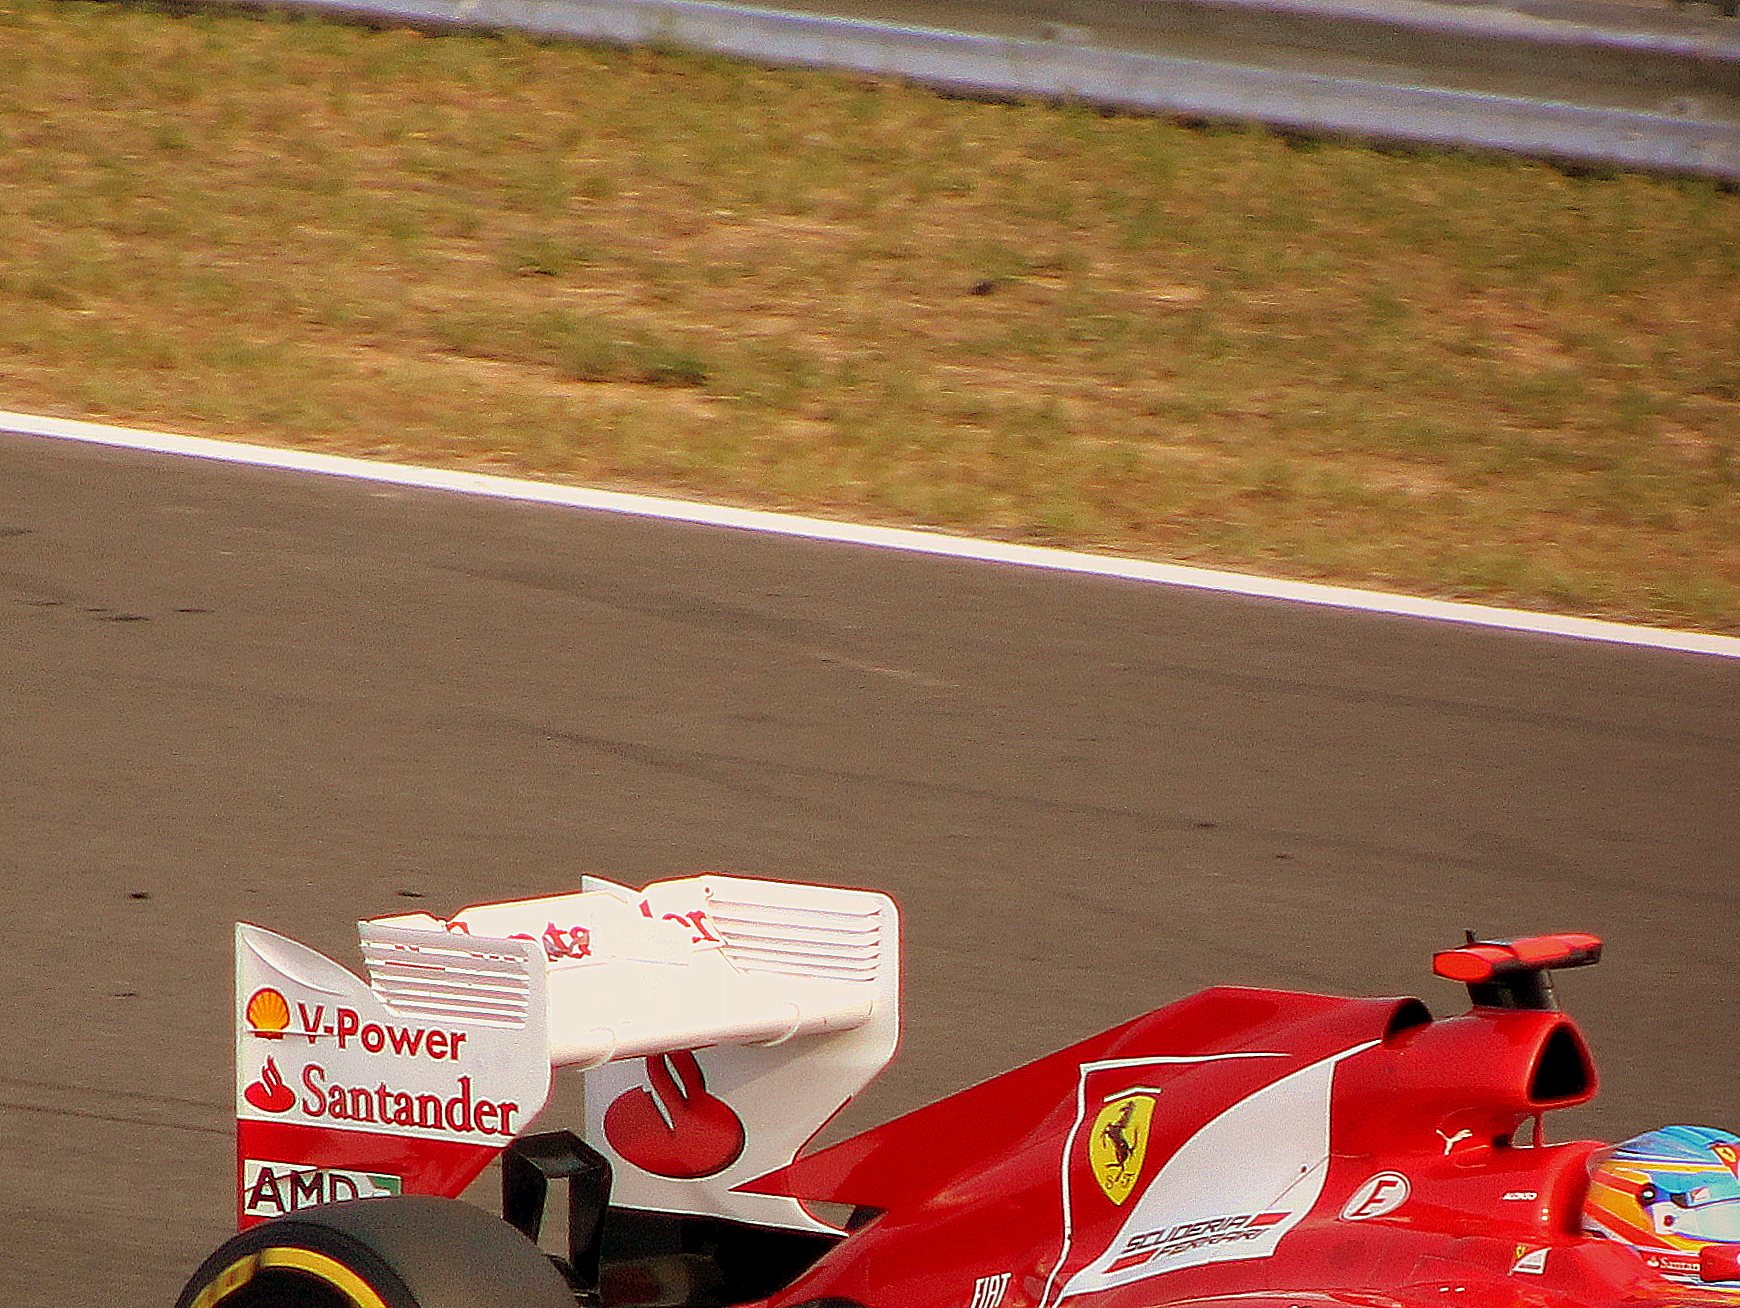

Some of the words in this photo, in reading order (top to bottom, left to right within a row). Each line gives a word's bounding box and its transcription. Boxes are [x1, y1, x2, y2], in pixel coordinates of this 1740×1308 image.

[298, 1002, 467, 1060] V-Power
[302, 1063, 519, 1136] Santander
[246, 1166, 360, 1213] AMD
[1120, 1214, 1253, 1254] SCUDERIA
